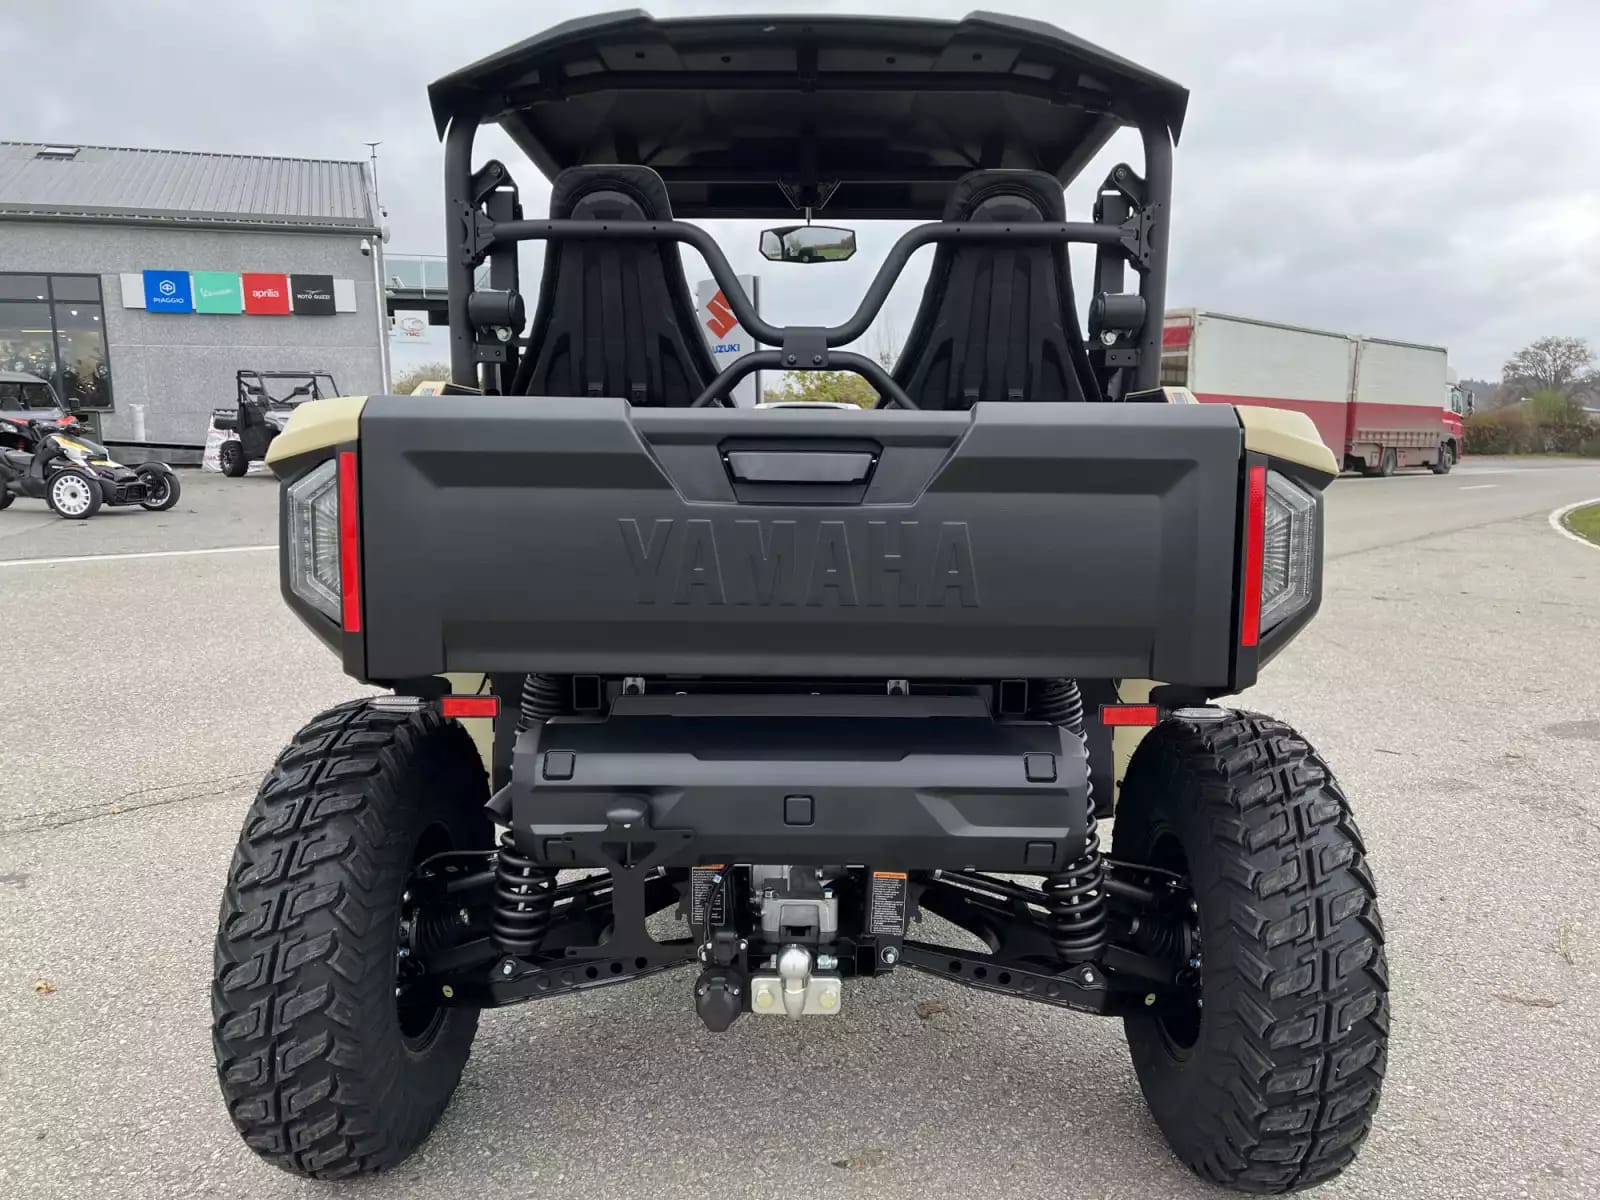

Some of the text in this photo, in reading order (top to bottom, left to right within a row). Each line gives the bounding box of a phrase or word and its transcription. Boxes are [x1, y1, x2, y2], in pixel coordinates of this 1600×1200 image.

[252, 288, 280, 300] aprilia
[711, 343, 741, 353] UZUKI
[616, 518, 981, 608] YAMAHA
